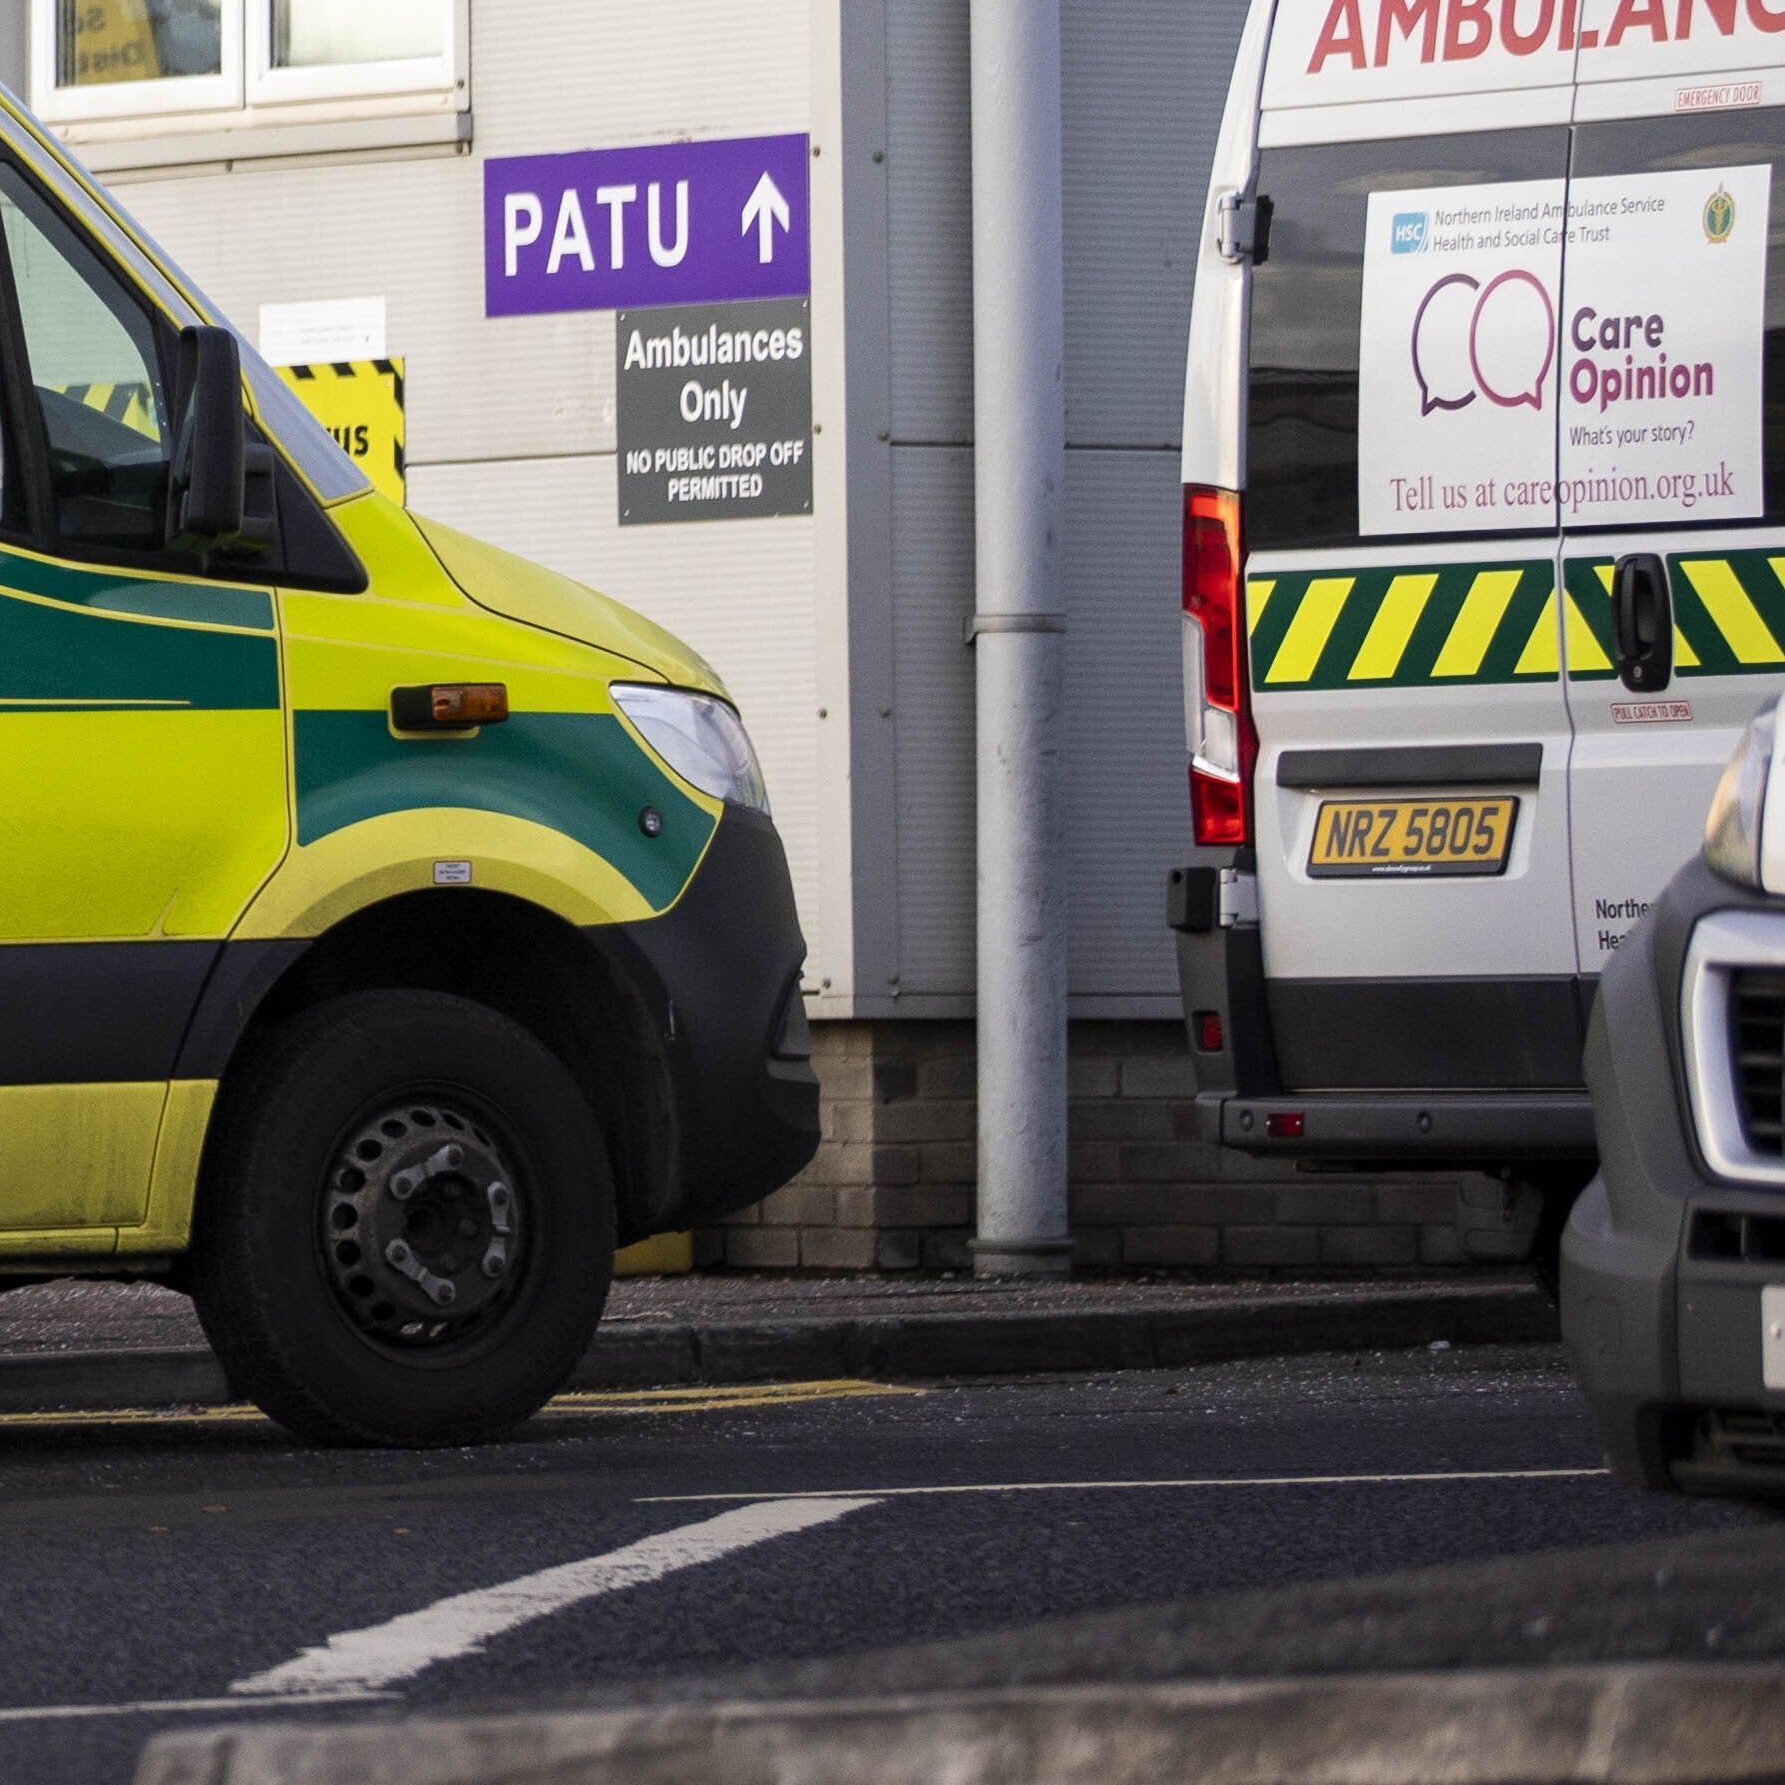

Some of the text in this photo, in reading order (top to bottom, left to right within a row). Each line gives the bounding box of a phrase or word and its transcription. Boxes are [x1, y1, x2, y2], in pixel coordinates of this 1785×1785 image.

[1677, 85, 1759, 107] EMERGENCY DOOR
[504, 179, 689, 277] PATU
[1435, 197, 1665, 226] Northern Ireland Ambulance Service
[1394, 223, 1423, 242] HSC
[1433, 226, 1610, 252] Health and Social Care Trust
[1571, 306, 1664, 352] Care
[623, 323, 804, 370] Ambulances
[1569, 352, 1713, 414] Opinion
[680, 379, 748, 430] Only
[1569, 420, 1695, 448] What's your story?
[626, 439, 805, 475] NO PUBLIC DROP OFF
[667, 472, 764, 502] PERMITTED
[1389, 460, 1735, 514] Tell us at careopinion.org.uk
[1614, 704, 1691, 720] PULL CATCH TO OPEN
[1324, 806, 1500, 858] NRZ 5805
[1595, 898, 1651, 919] Northe
